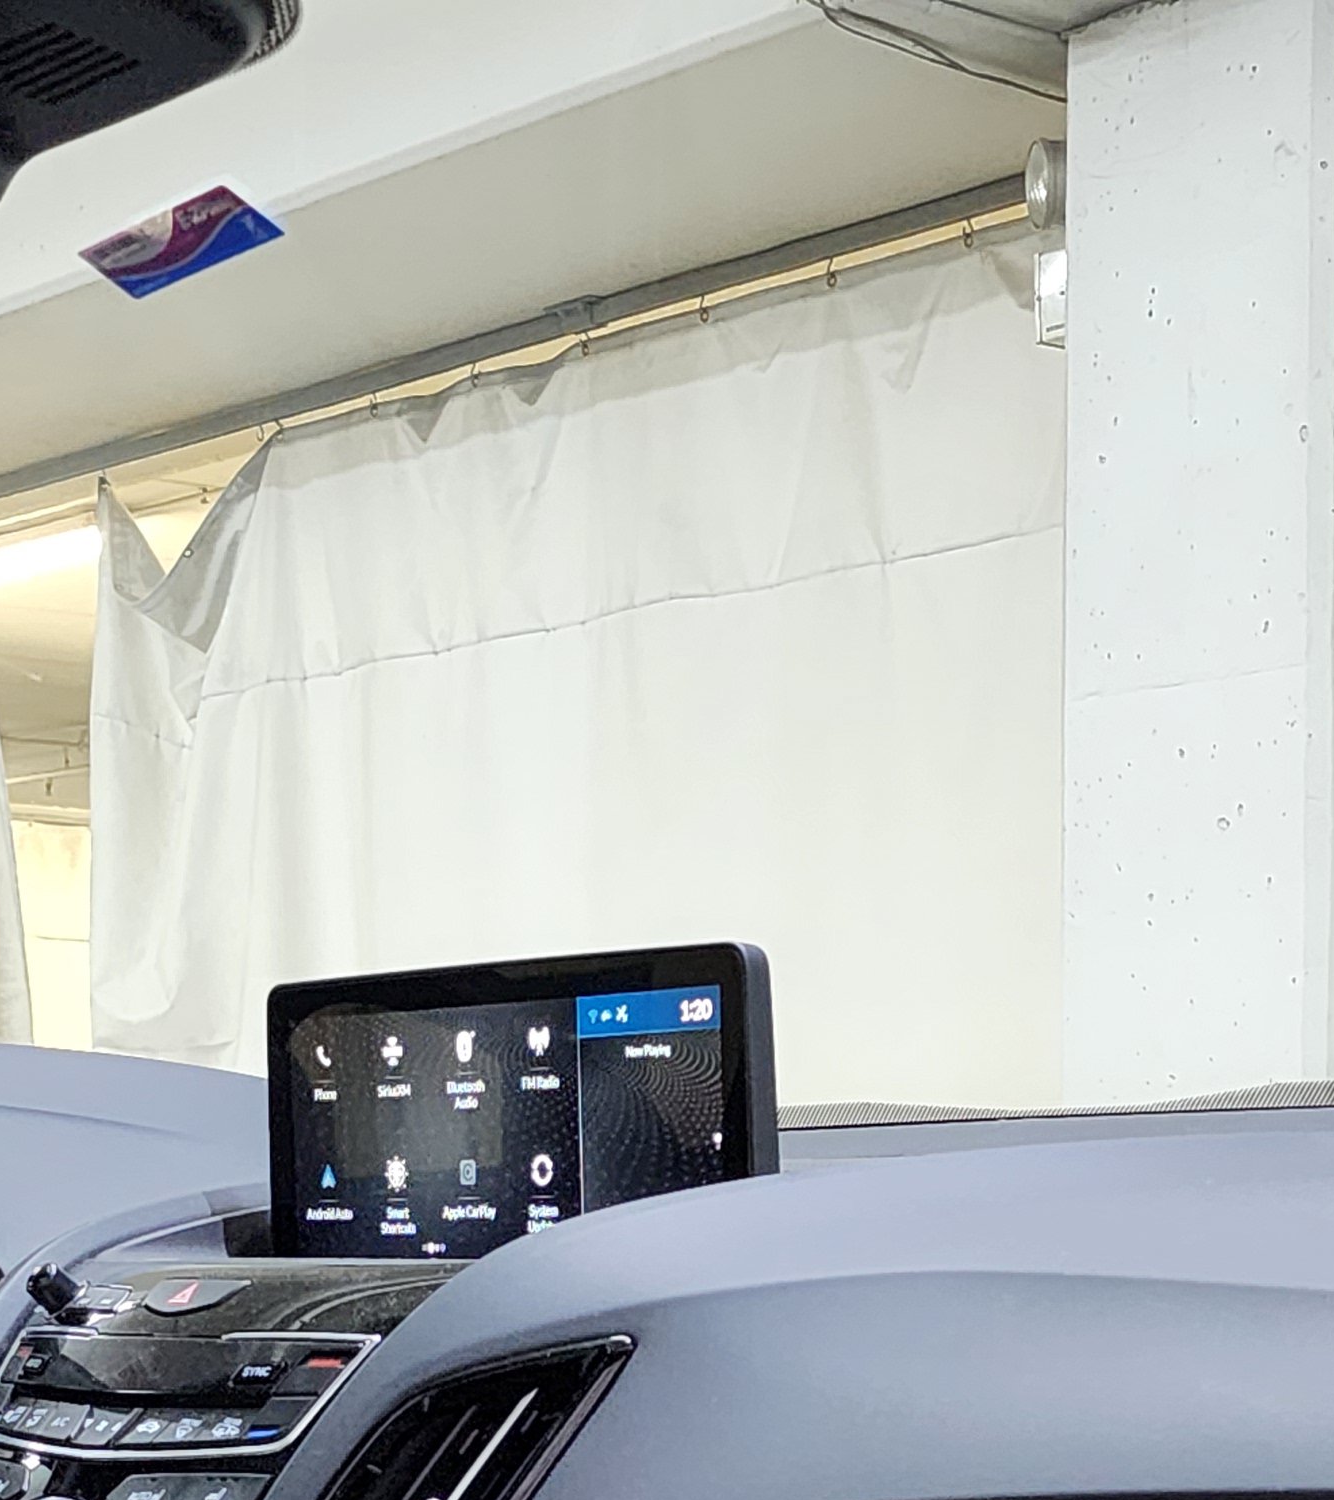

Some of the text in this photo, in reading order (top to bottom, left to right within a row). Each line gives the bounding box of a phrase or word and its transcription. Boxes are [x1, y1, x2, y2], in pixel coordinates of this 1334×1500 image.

[680, 997, 713, 1023] 1:20
[624, 1043, 671, 1058] Now Playing
[521, 1074, 560, 1091] FM Radio
[314, 1087, 337, 1101] Phone
[306, 1206, 354, 1220] Android Auto
[386, 1205, 410, 1219] Smart
[442, 1202, 496, 1221] Apple CarPlay
[528, 1203, 559, 1220] System
[380, 1221, 417, 1235] Shortcuts
[242, 1365, 272, 1378] SYNC
